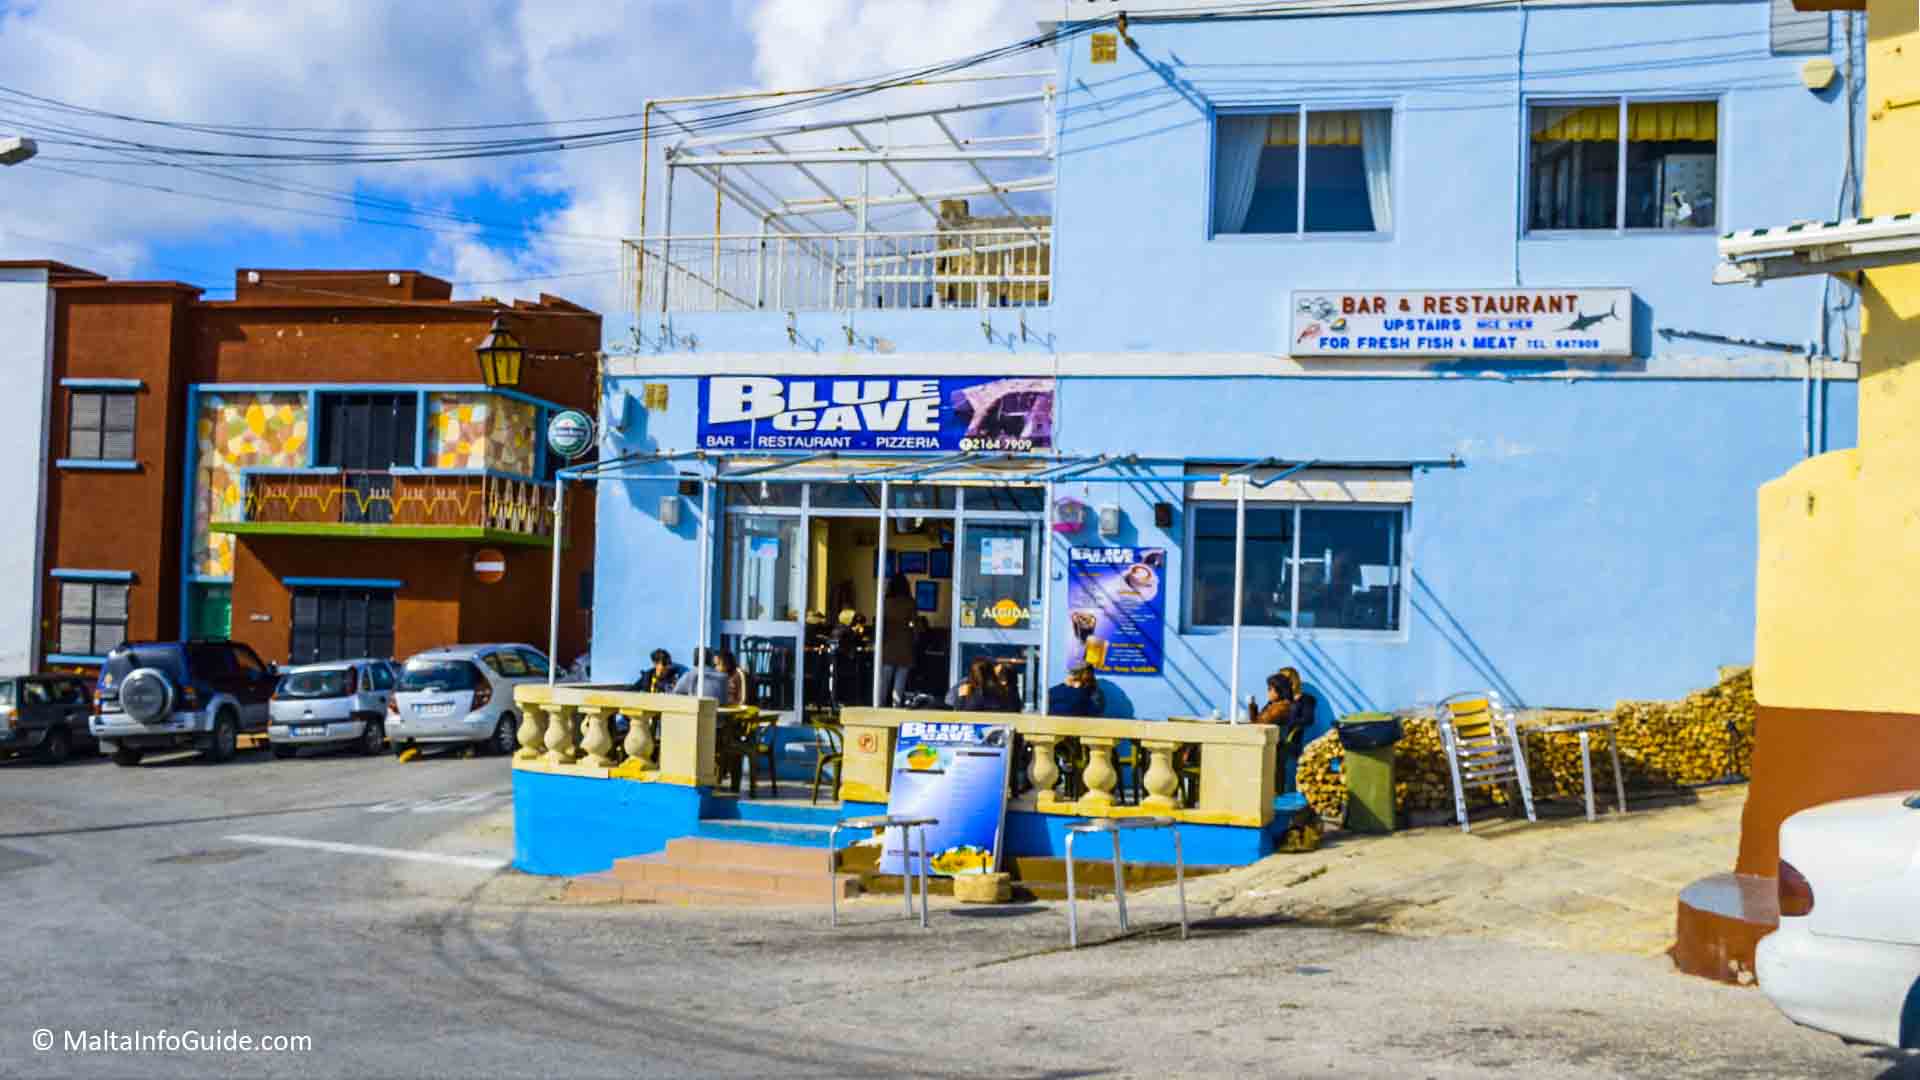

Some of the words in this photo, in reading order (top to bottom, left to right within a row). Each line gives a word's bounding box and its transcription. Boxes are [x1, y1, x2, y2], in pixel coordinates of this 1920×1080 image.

[1342, 296, 1387, 313] BAR
[1399, 298, 1411, 313] &
[1424, 295, 1579, 313] RESTAURANT
[1383, 319, 1462, 331] UPSTAIRS
[1319, 337, 1350, 349] FOR
[1357, 337, 1410, 349] FRESH
[1417, 337, 1454, 349] FISH
[1472, 336, 1517, 349] MEAT
[708, 376, 940, 425] BLUE
[772, 397, 941, 431] CAVE
[706, 435, 736, 447] BAR
[758, 436, 852, 448] RESTAURANT
[876, 436, 941, 449] PIZZERIA
[972, 438, 1001, 450] 2164
[1004, 438, 1032, 450] 7909
